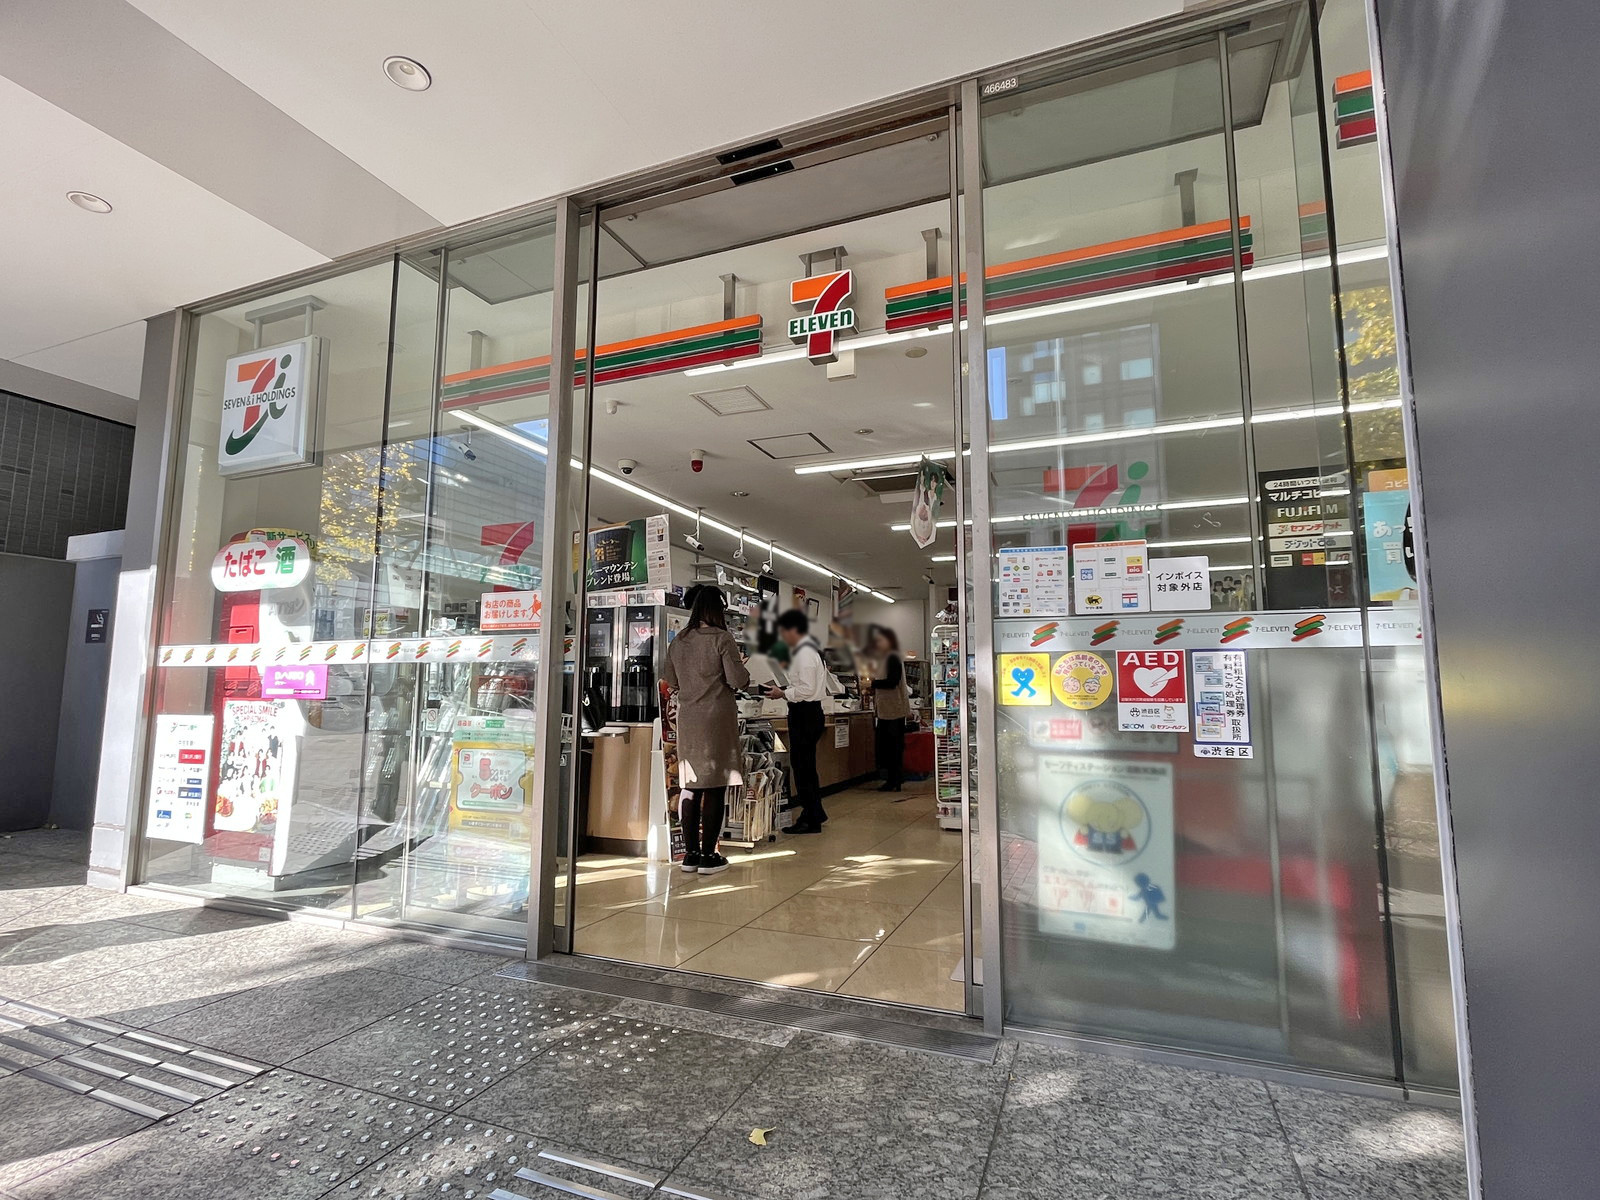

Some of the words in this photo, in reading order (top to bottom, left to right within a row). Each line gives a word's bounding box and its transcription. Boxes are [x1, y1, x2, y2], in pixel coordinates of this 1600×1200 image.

[984, 78, 1017, 94] 466483
[255, 386, 296, 404] HOLDINGS
[224, 548, 267, 578] たばこ
[275, 545, 297, 575] 酒
[1156, 571, 1204, 581] インボイス
[1157, 582, 1203, 593] 対象外店
[484, 598, 522, 609] お店の商品
[1122, 652, 1180, 667] AED
[1223, 653, 1235, 718] 有料ごみ処理券
[1234, 653, 1245, 718] 有料粗大ごみ処理券
[233, 704, 257, 716] SPECIAL
[259, 705, 278, 717] SMILE
[1231, 718, 1242, 741] 取扱所
[1211, 746, 1249, 757] 渋谷区
[469, 781, 513, 801] クーポン
